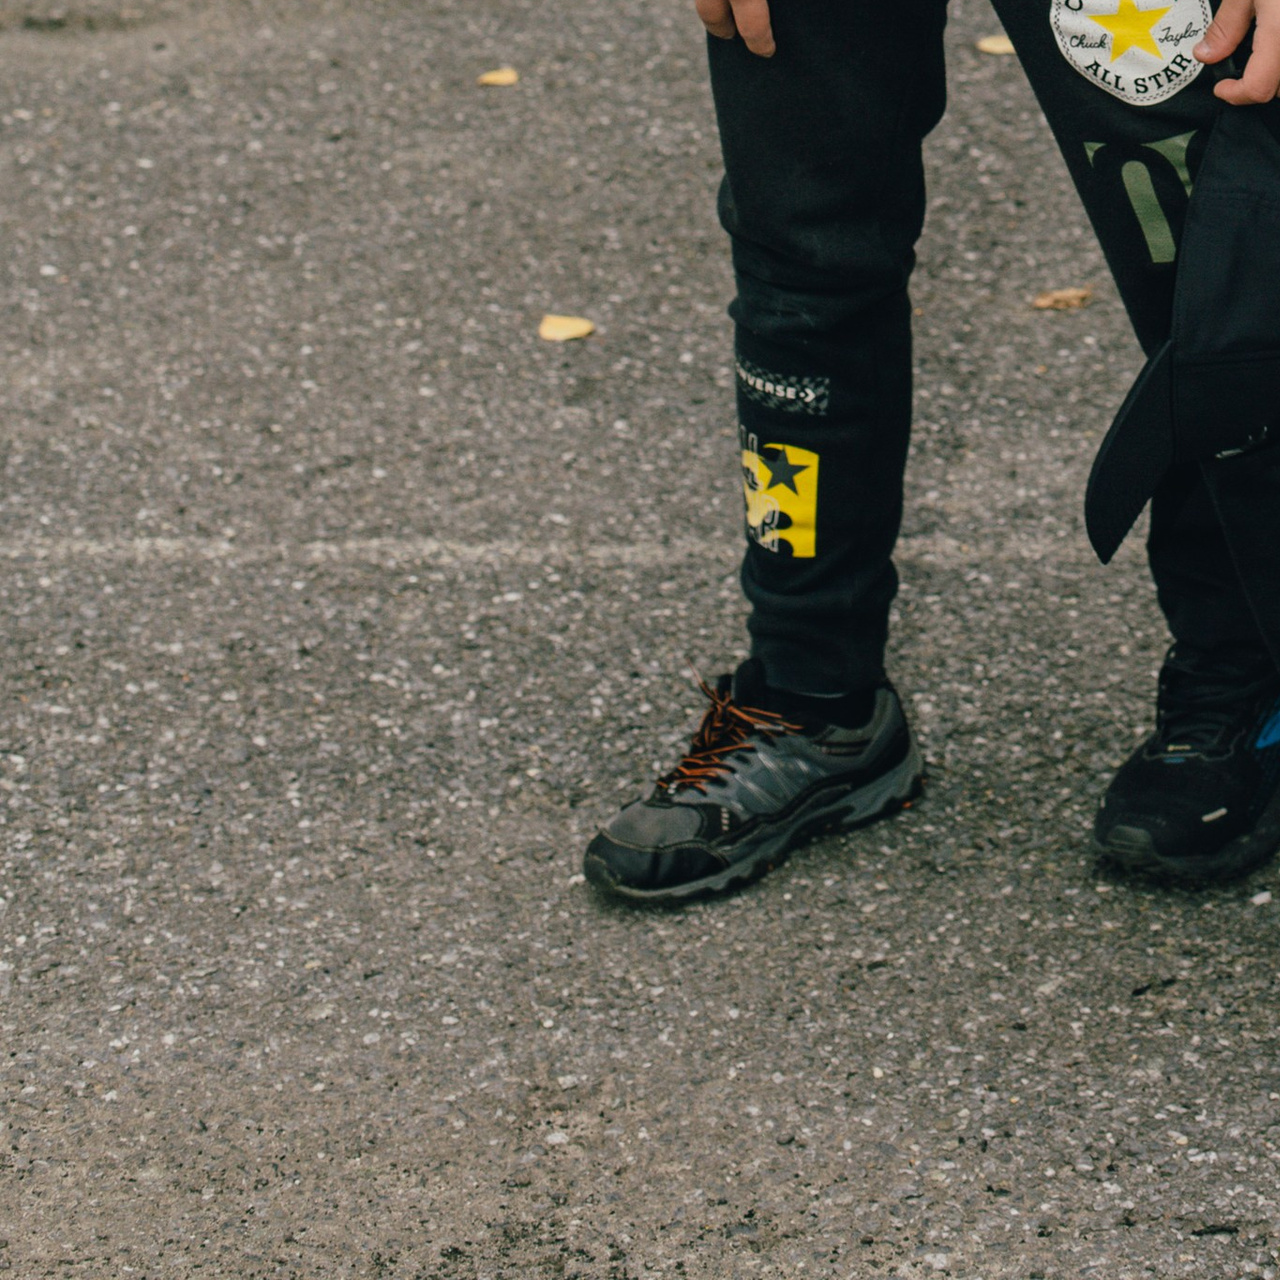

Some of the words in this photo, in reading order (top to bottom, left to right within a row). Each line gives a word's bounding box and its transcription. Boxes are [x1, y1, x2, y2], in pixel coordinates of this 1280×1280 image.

[1069, 33, 1108, 49] Chuck
[1158, 21, 1203, 47] Taylor
[1085, 56, 1126, 92] ALL
[1134, 51, 1193, 94] STAR
[736, 363, 797, 400] NVERSE
